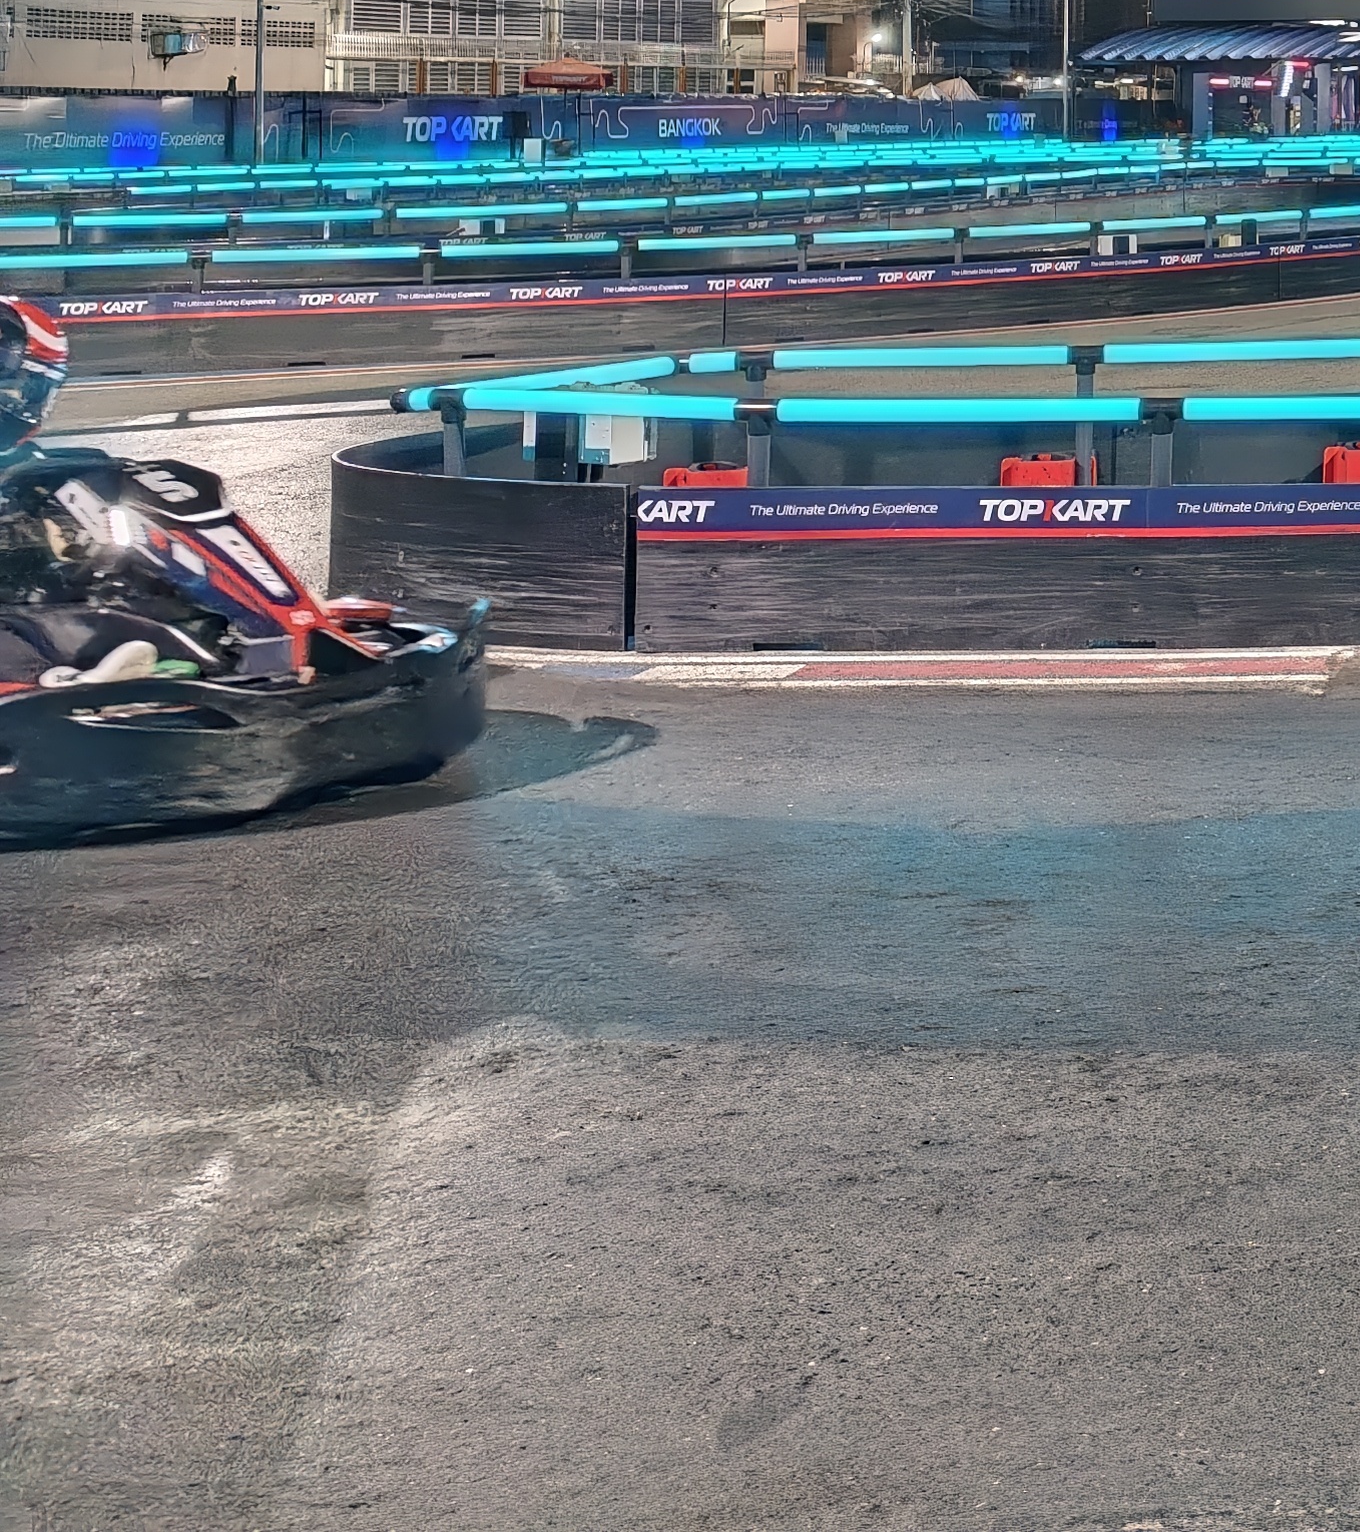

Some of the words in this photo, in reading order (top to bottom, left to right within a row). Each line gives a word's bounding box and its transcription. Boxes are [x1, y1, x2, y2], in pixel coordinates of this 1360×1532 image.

[658, 118, 722, 137] BANGKOK
[750, 505, 773, 517] The
[776, 504, 824, 517] Ultimate
[828, 503, 870, 517] Driving
[872, 502, 938, 516] Experience
[979, 499, 1130, 522] TOPKART
[1177, 502, 1200, 514] The
[1203, 501, 1252, 514] Ultimate
[1254, 500, 1294, 514] Driving
